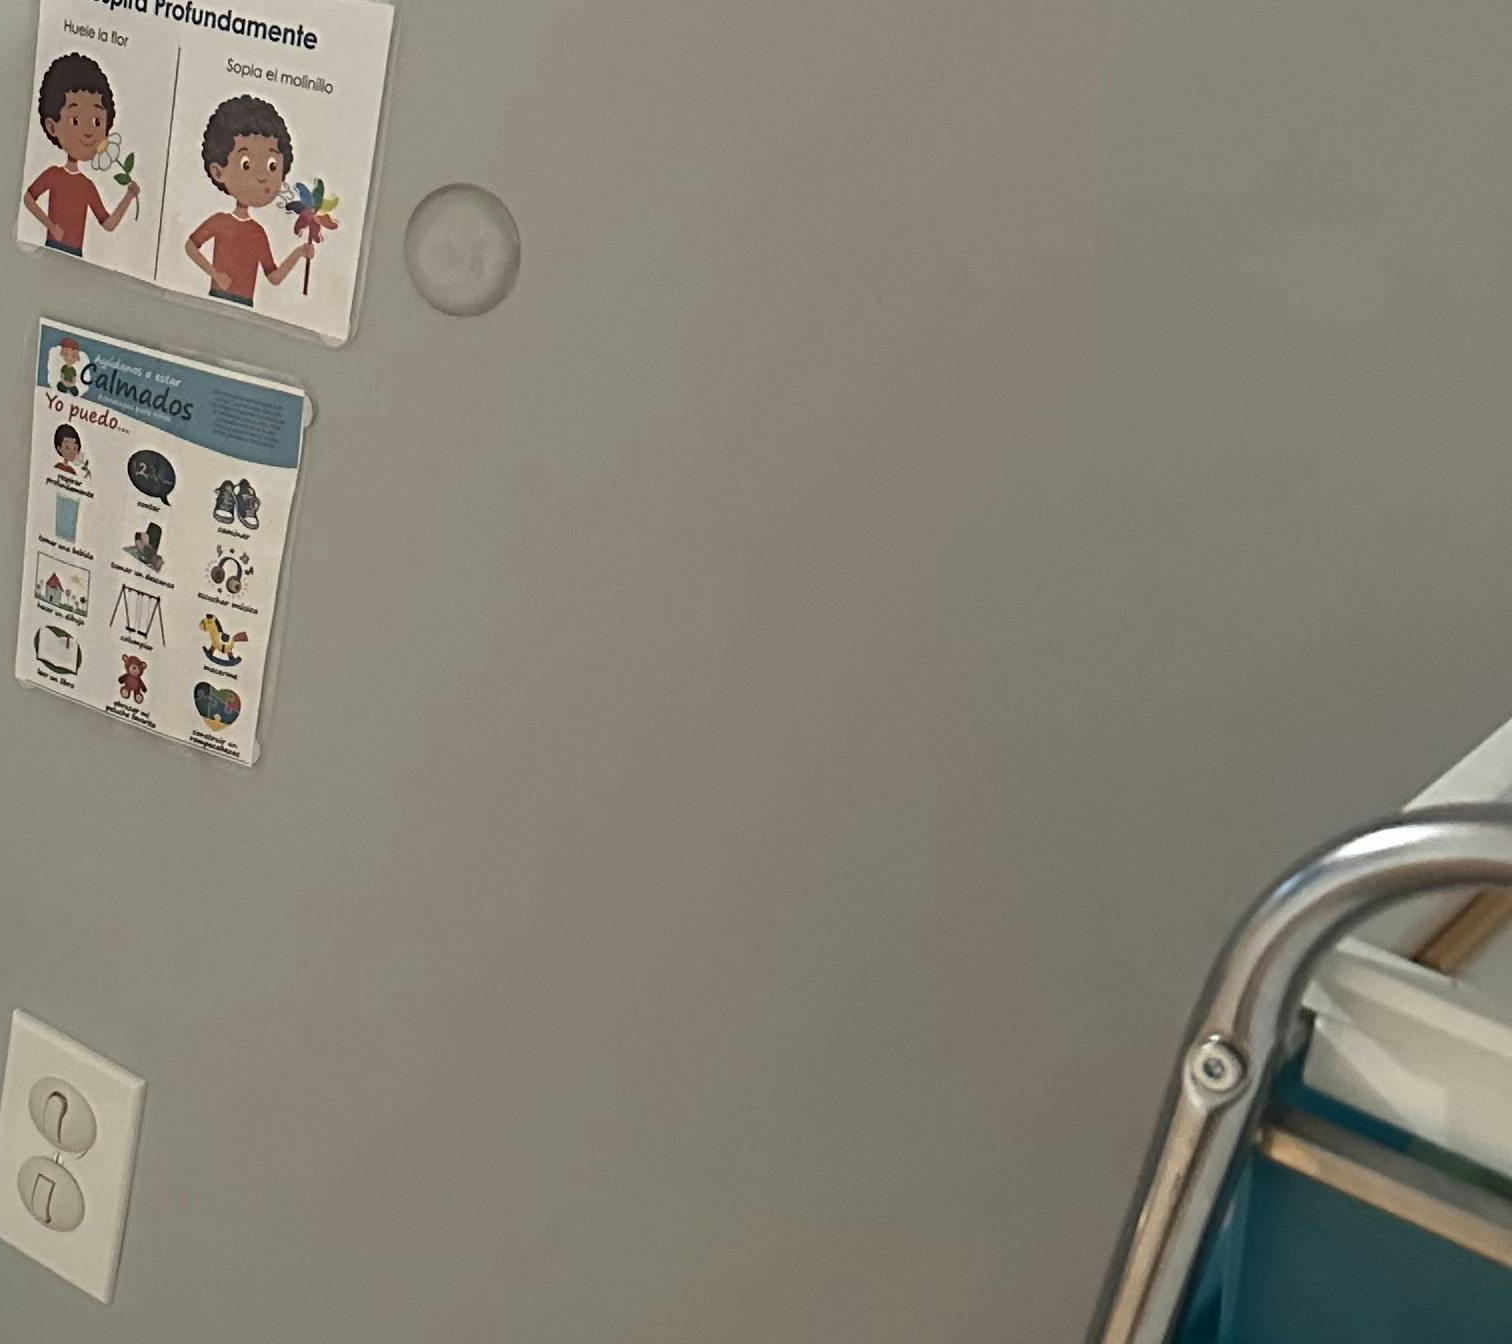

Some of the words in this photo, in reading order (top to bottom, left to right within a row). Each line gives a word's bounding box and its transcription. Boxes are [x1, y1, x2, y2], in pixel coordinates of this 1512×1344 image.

[63, 20, 95, 39] Huele
[98, 28, 108, 42] la
[111, 31, 129, 47] flor
[226, 58, 262, 79] Sopla
[266, 67, 277, 82] el
[281, 71, 333, 95] molinillo
[80, 363, 195, 421] Calmados
[155, 373, 183, 387] estar
[46, 392, 64, 412] Yo
